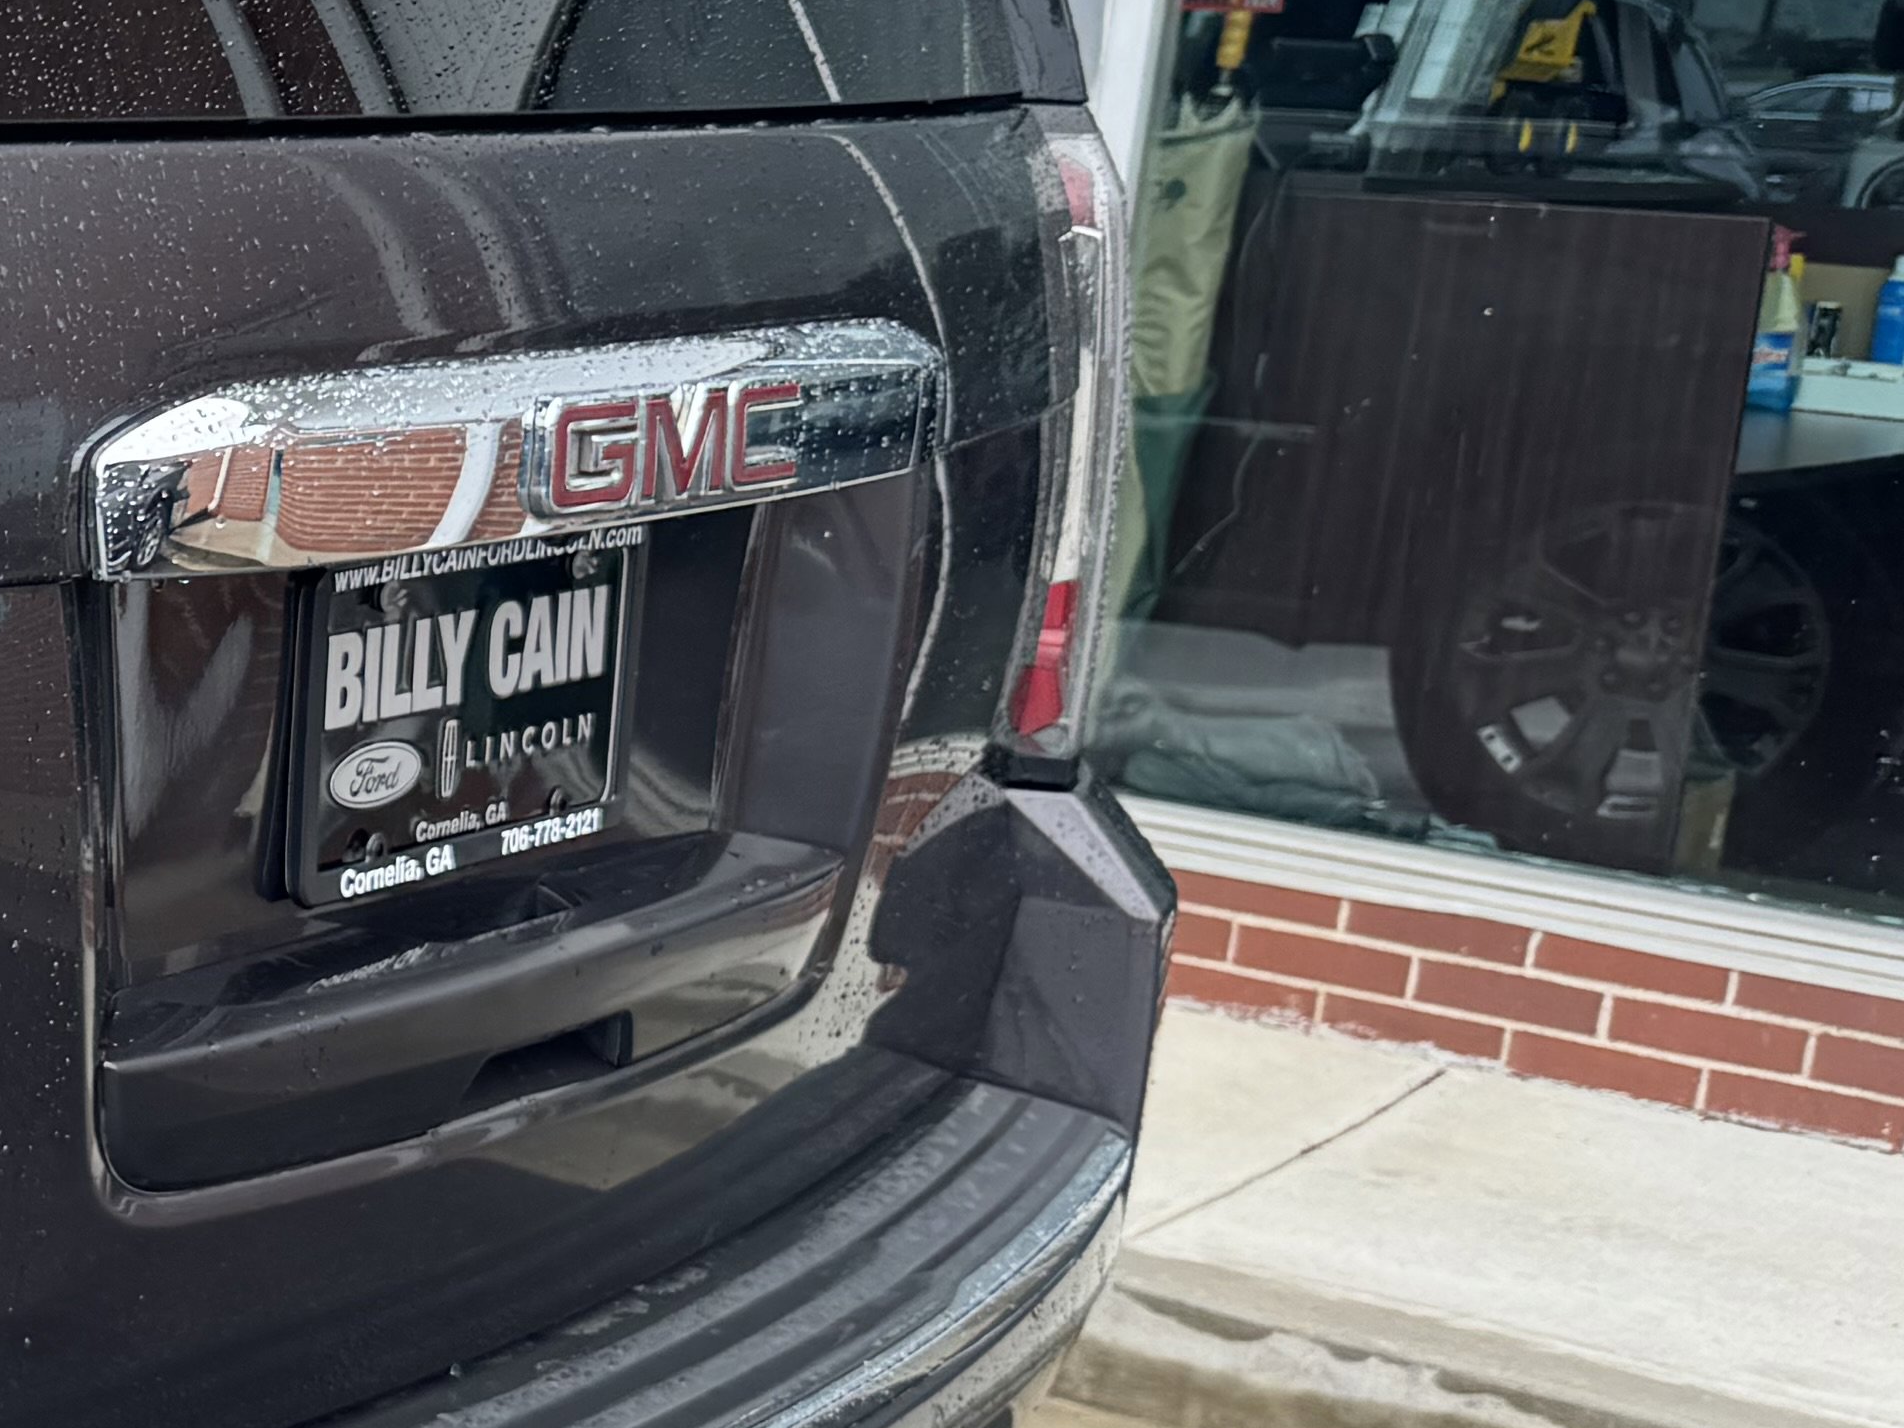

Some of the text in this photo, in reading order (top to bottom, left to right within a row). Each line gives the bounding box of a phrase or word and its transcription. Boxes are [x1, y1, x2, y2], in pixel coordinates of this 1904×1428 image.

[550, 383, 802, 509] GMC
[324, 584, 612, 731] BILLY CAIN
[465, 712, 595, 768] LINCOLN
[340, 806, 604, 900] Cornelia, GA 706-778-2121
[415, 800, 509, 844] Cornelia, GA
